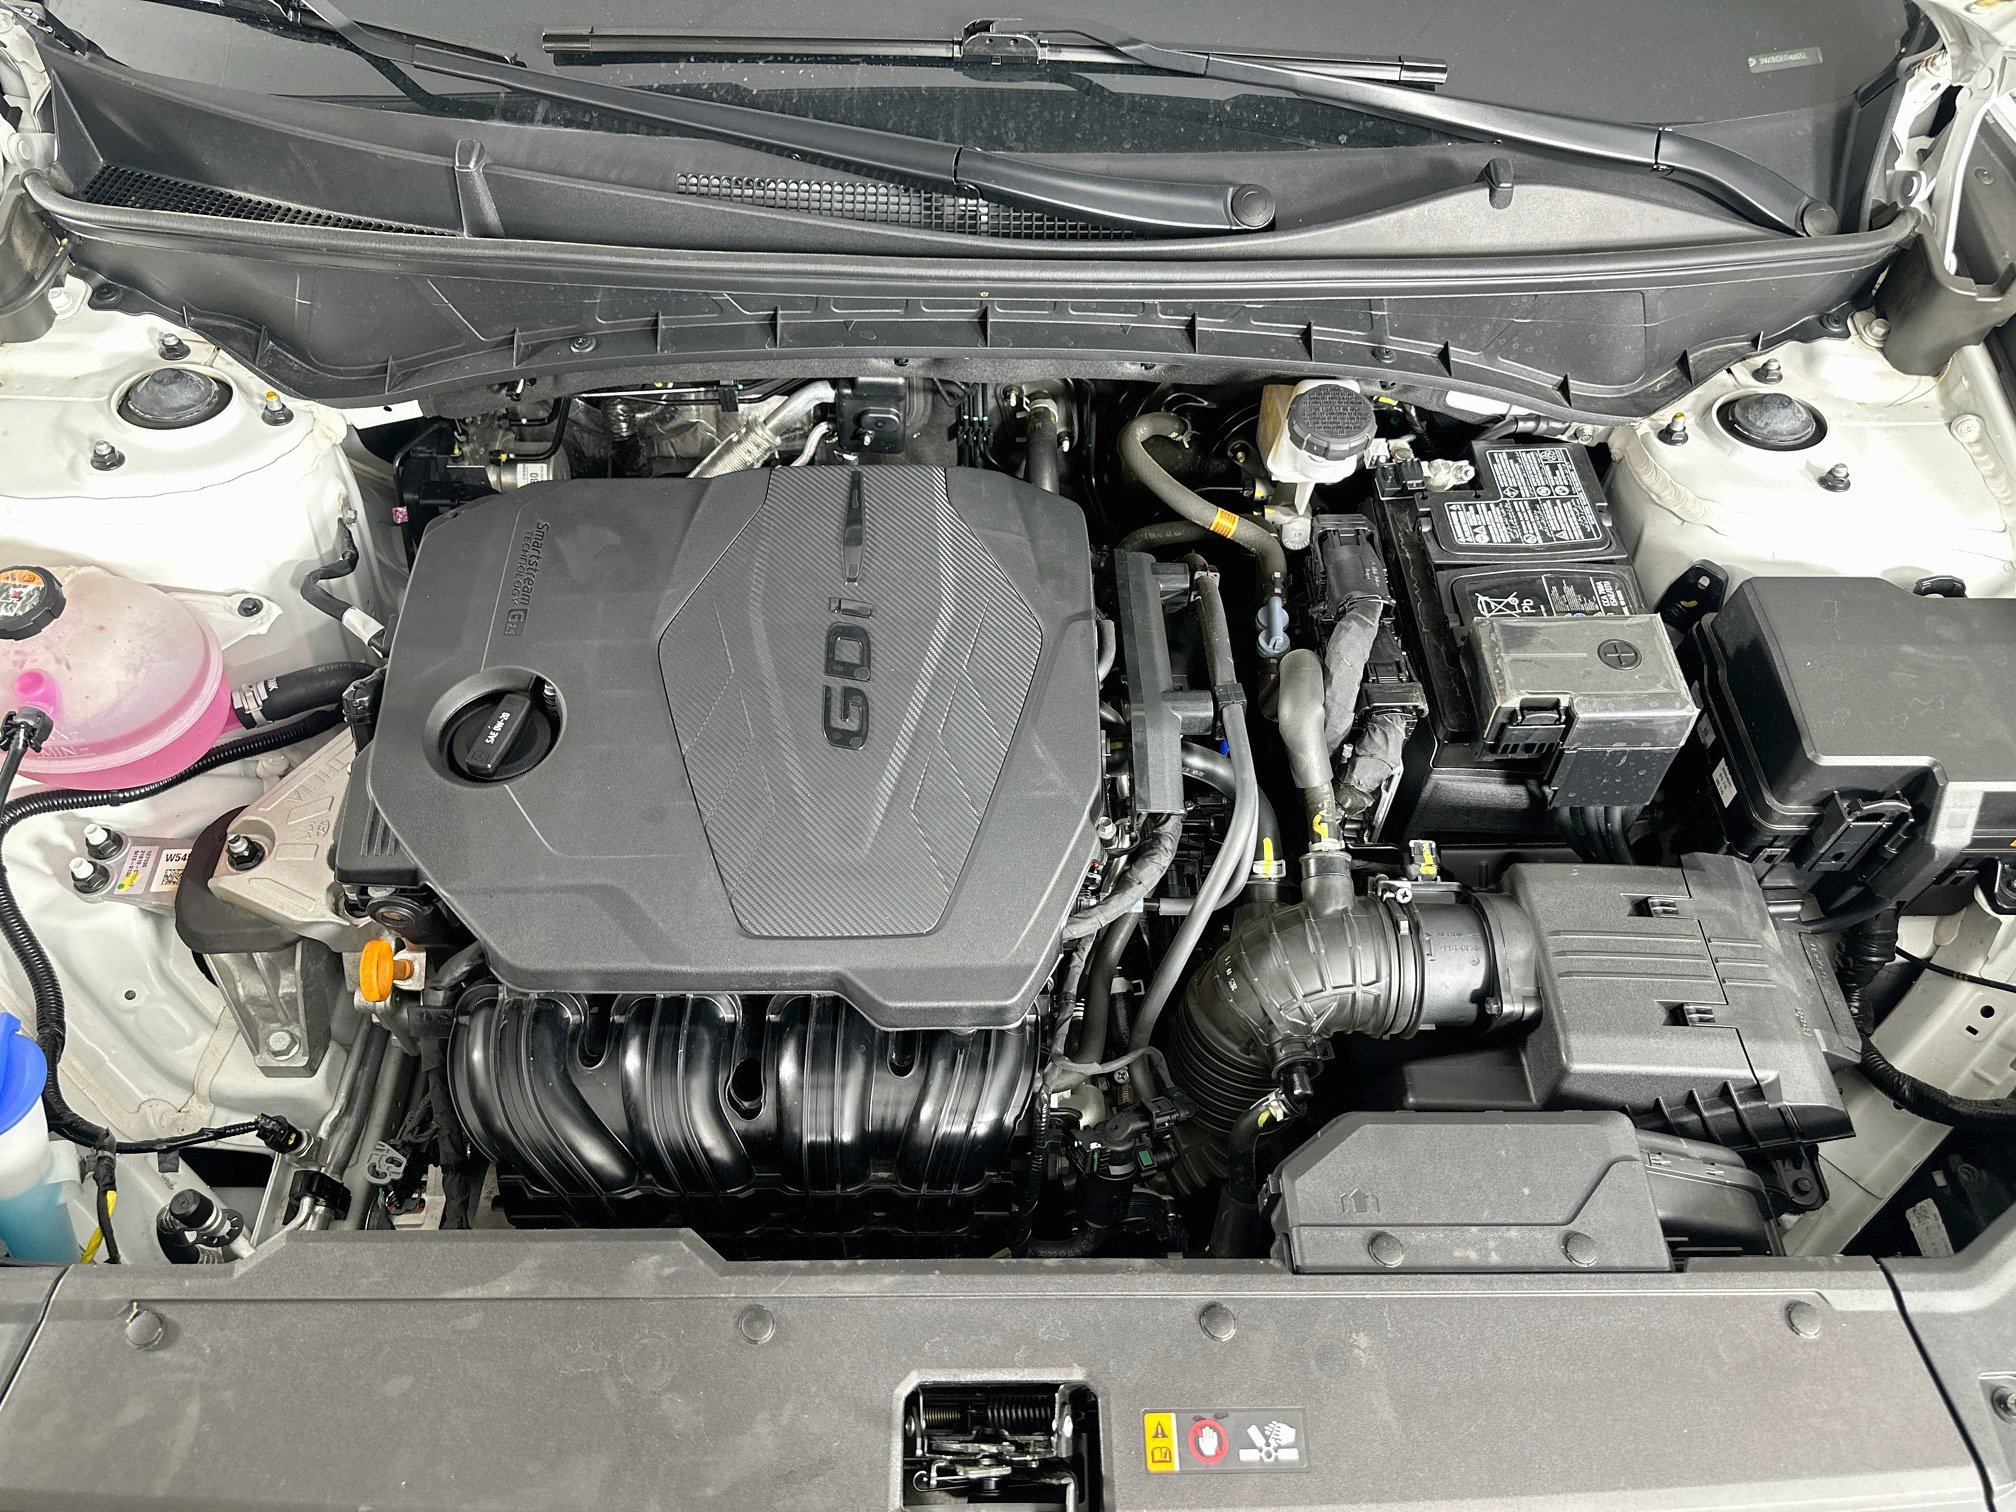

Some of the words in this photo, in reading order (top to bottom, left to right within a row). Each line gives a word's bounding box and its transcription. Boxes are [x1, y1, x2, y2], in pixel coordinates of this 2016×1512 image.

[509, 530, 534, 606] TECHNOLOGY
[520, 521, 550, 606] Smartstream
[1521, 599, 1536, 613] Pb
[823, 596, 873, 750] GDi
[485, 730, 499, 744] SAE
[286, 758, 350, 803] THETA
[165, 853, 190, 862] W54
